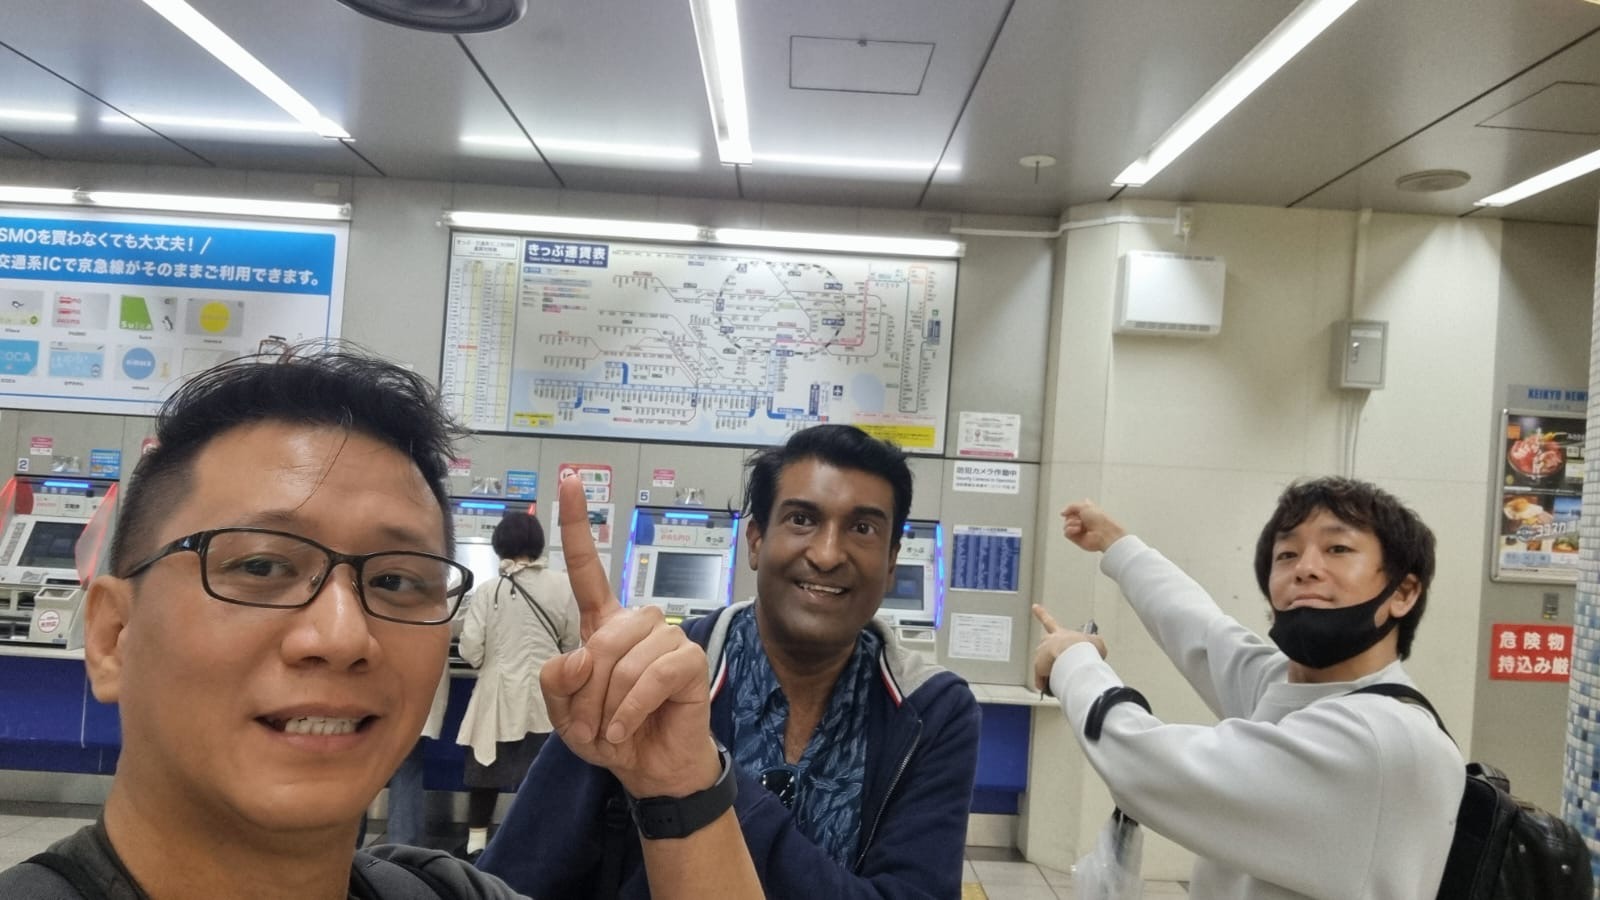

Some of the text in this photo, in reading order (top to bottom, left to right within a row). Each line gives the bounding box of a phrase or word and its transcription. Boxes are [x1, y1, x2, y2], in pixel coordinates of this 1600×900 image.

[528, 243, 606, 261] きっぷ運賃表
[19, 459, 28, 470] 2
[640, 491, 649, 501] 5
[1499, 631, 1565, 651] 危険物
[1497, 655, 1569, 675] 持込み厳
